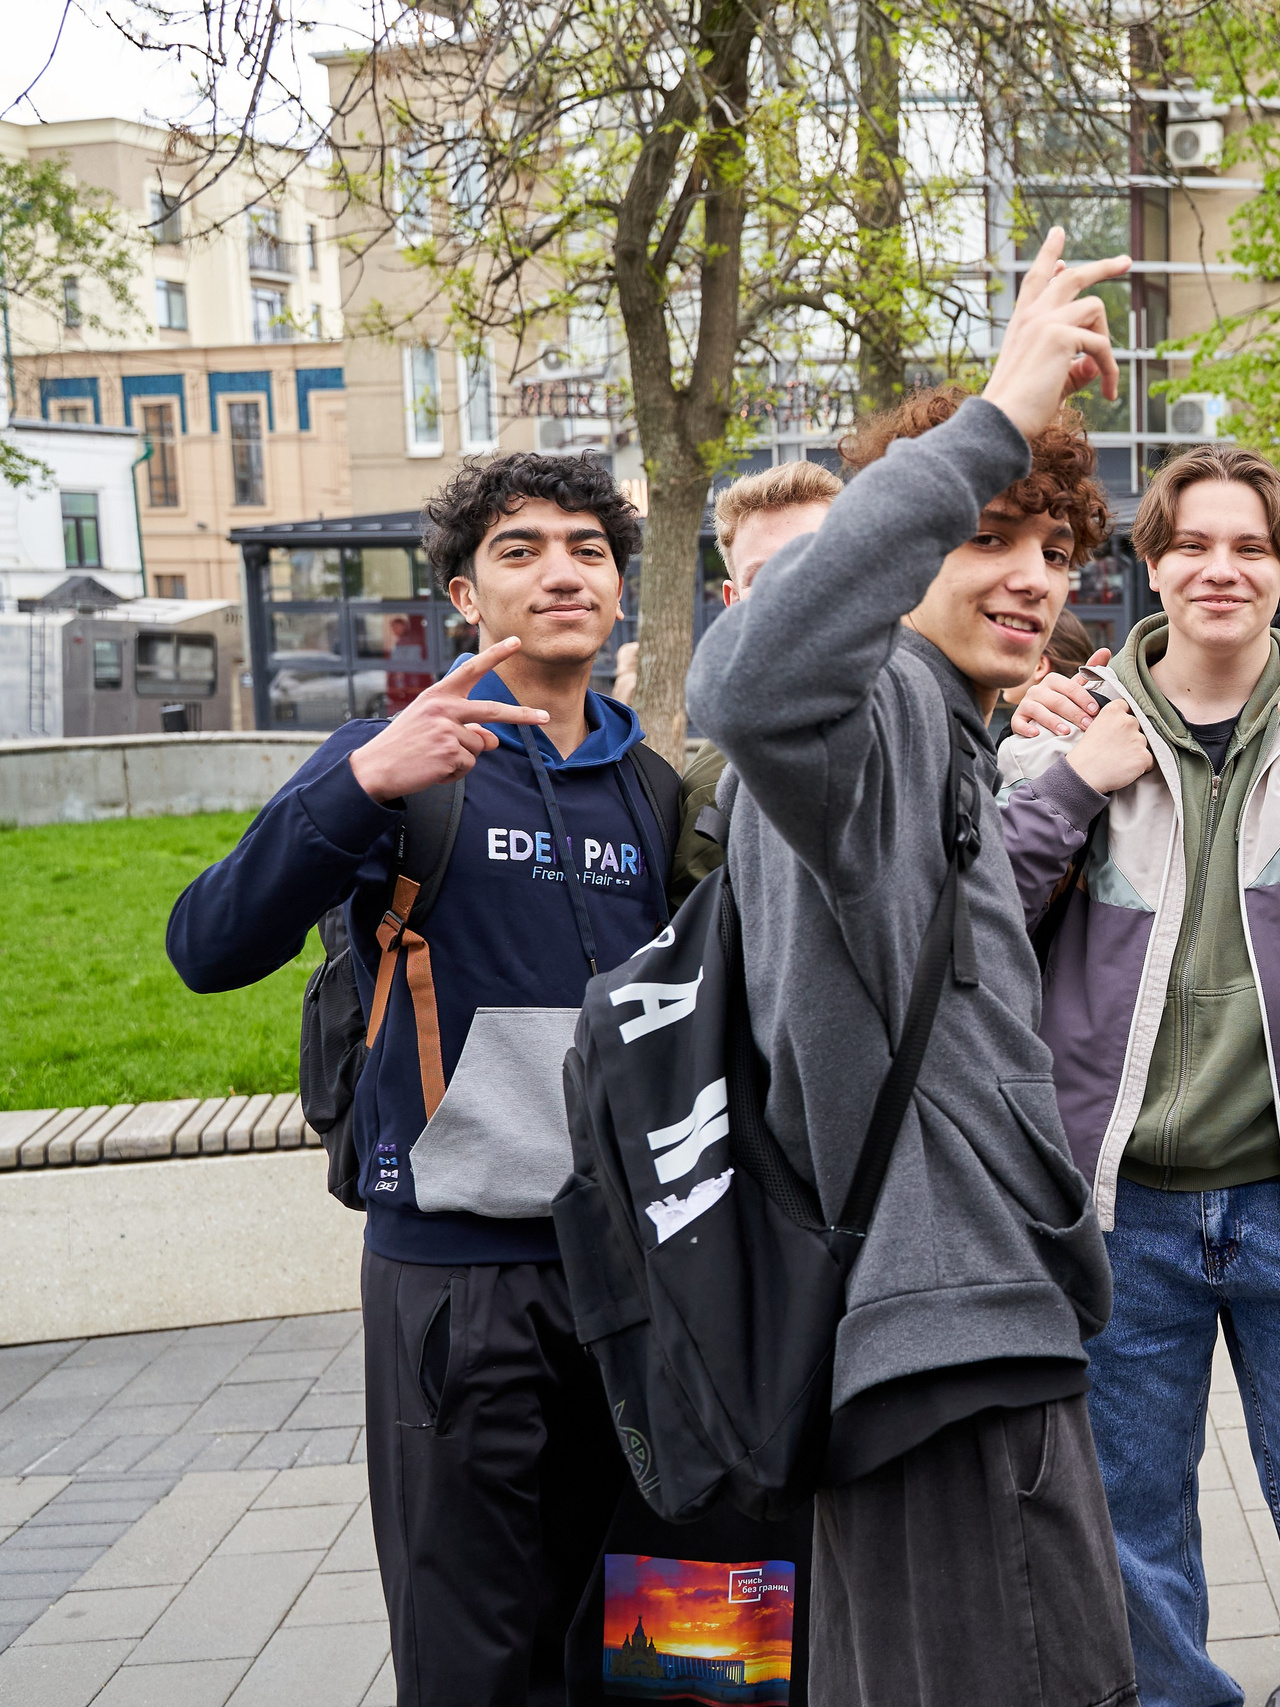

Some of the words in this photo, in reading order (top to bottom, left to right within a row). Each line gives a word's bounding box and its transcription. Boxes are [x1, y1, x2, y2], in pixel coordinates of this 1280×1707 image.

[532, 866, 580, 881] Fren
[583, 871, 613, 886] Flair
[738, 1577, 762, 1587] учись
[759, 1584, 789, 1593] границ
